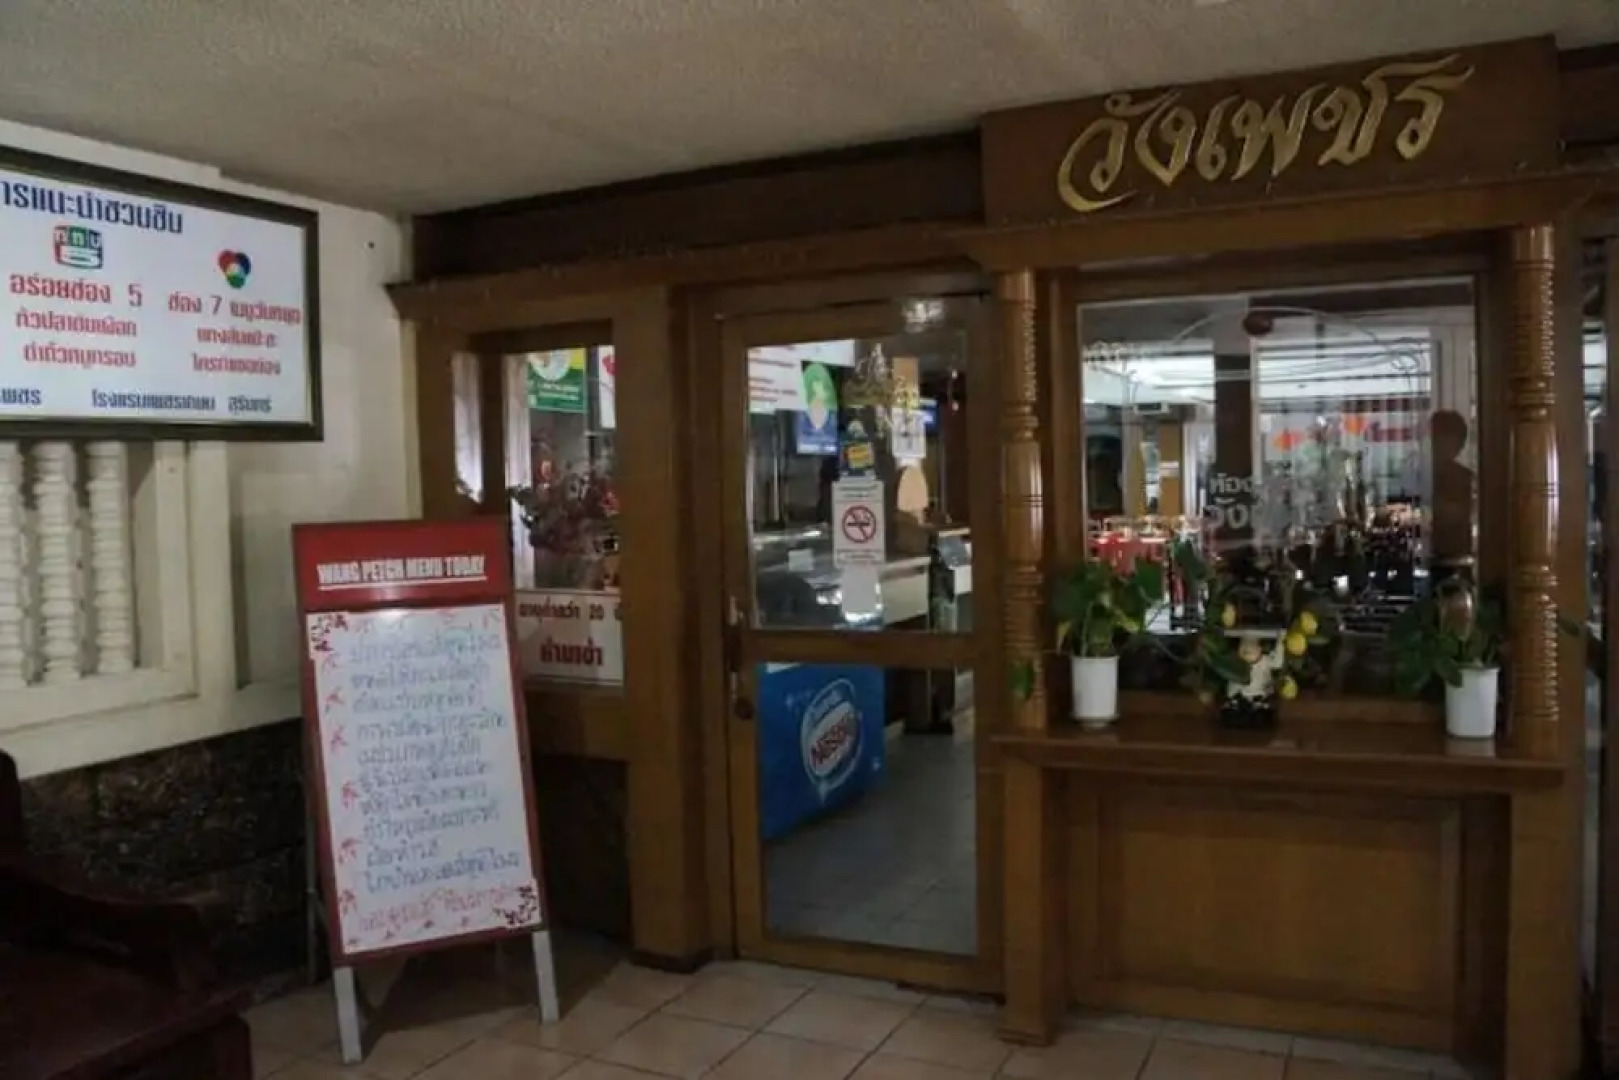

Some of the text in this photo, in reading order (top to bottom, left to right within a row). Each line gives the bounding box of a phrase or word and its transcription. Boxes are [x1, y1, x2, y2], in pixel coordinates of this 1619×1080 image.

[1057, 53, 1476, 212] วังเพชร
[128, 283, 142, 307] 5
[210, 295, 222, 315] 7
[406, 556, 443, 579] MENU
